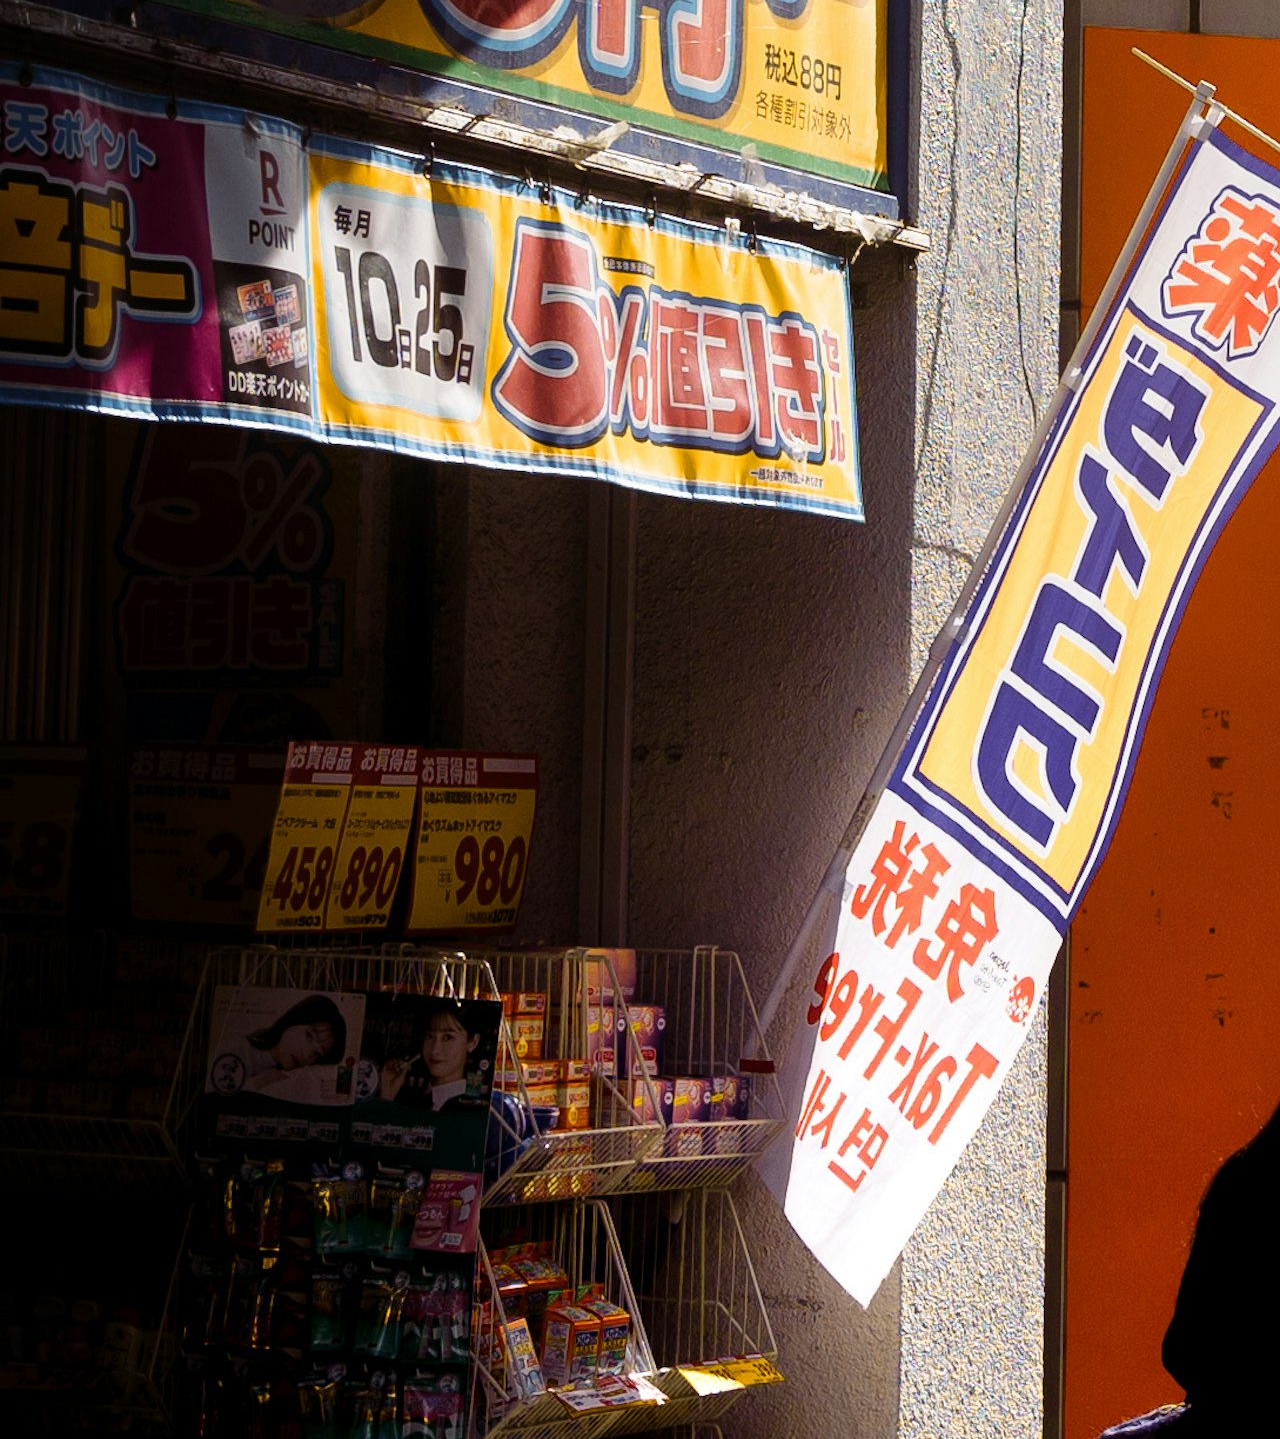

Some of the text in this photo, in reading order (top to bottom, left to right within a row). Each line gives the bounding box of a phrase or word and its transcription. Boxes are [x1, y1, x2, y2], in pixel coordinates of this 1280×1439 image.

[765, 43, 842, 101] 税込88円
[756, 90, 852, 143] 各種割引対象外
[250, 218, 296, 253] POINT
[333, 204, 371, 240] 毎月
[822, 327, 846, 462] セール
[131, 749, 237, 782] お買得品
[289, 746, 353, 771] お買得品
[360, 748, 418, 772] お買得品
[422, 757, 478, 785] お買得品
[272, 846, 333, 911] 458
[340, 846, 402, 910] 890
[455, 835, 526, 906] 980
